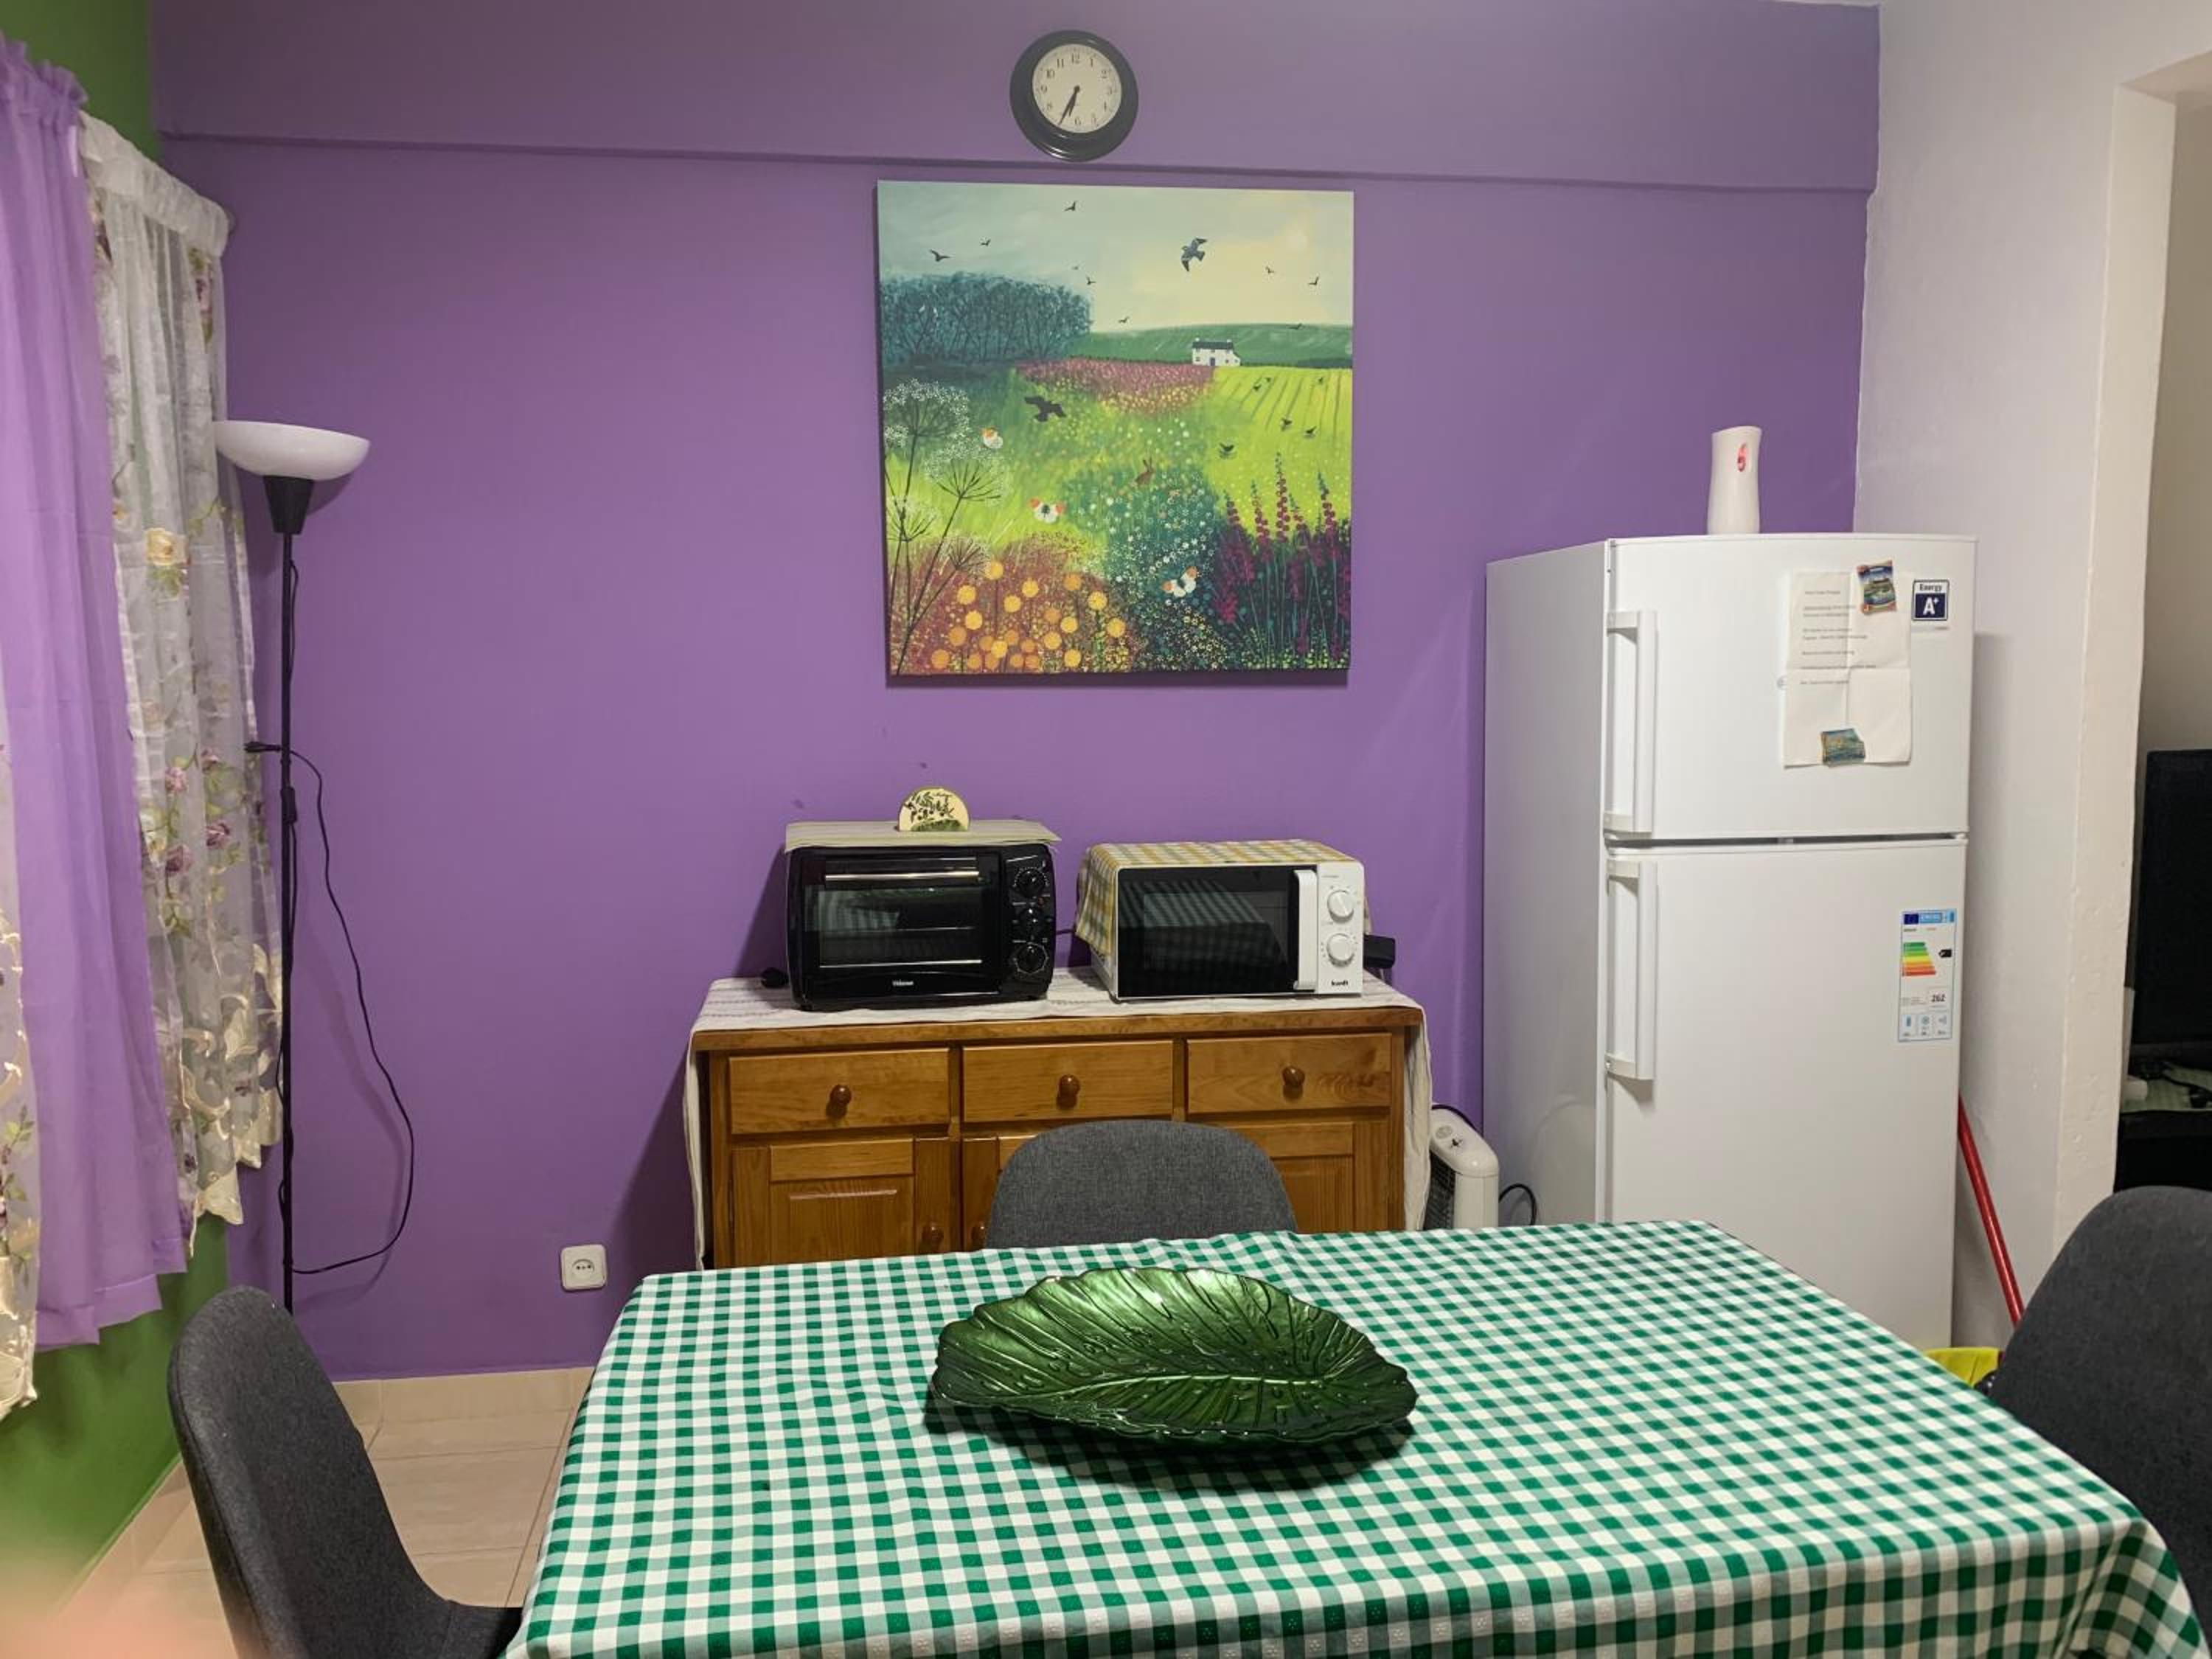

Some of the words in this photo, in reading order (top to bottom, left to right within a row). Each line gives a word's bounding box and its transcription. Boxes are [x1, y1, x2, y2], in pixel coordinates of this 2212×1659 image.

[1057, 58, 1064, 68] 11
[1071, 53, 1080, 64] 12
[1090, 58, 1093, 67] 1
[1919, 583, 1943, 592] Energy
